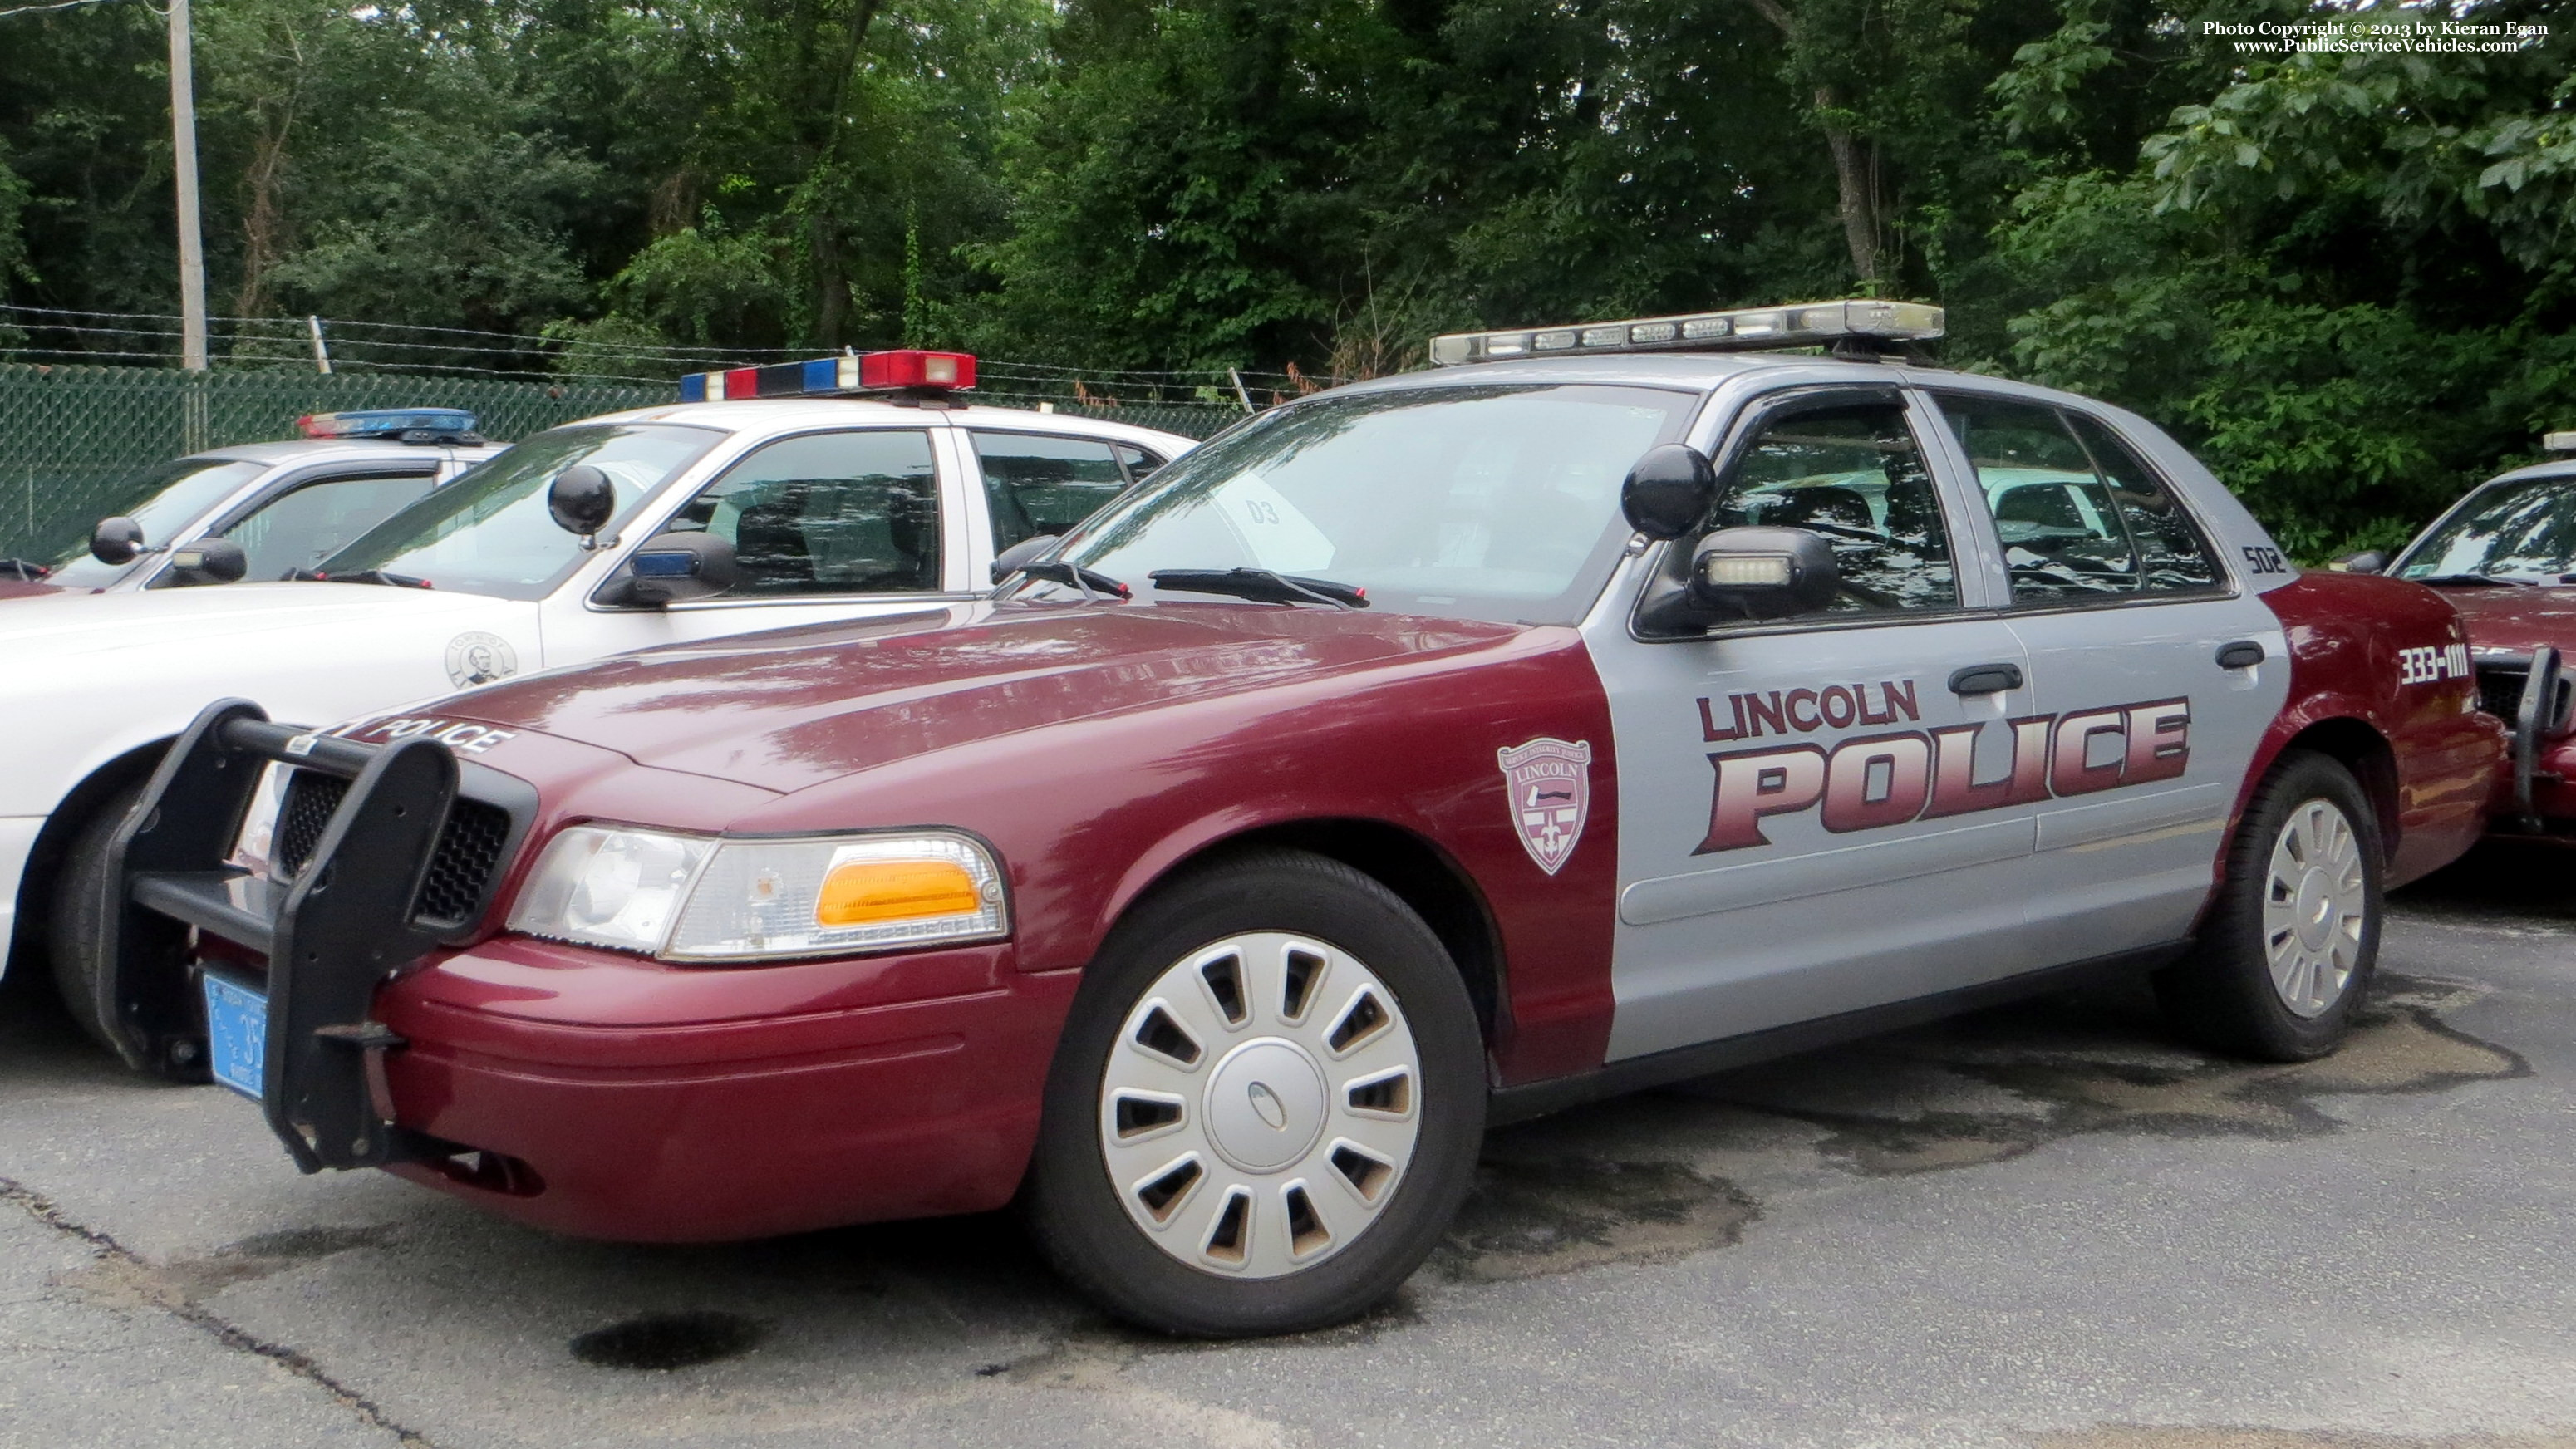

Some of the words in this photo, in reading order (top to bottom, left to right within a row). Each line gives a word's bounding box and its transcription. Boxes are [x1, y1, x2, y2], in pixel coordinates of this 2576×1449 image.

[2243, 547, 2287, 574] 502
[2399, 644, 2468, 685] 333-1111
[1696, 680, 1920, 743] LINCOLN
[366, 718, 516, 753] POLICE
[1516, 762, 1577, 783] LINCOLN
[1690, 695, 2192, 857] POLICE
